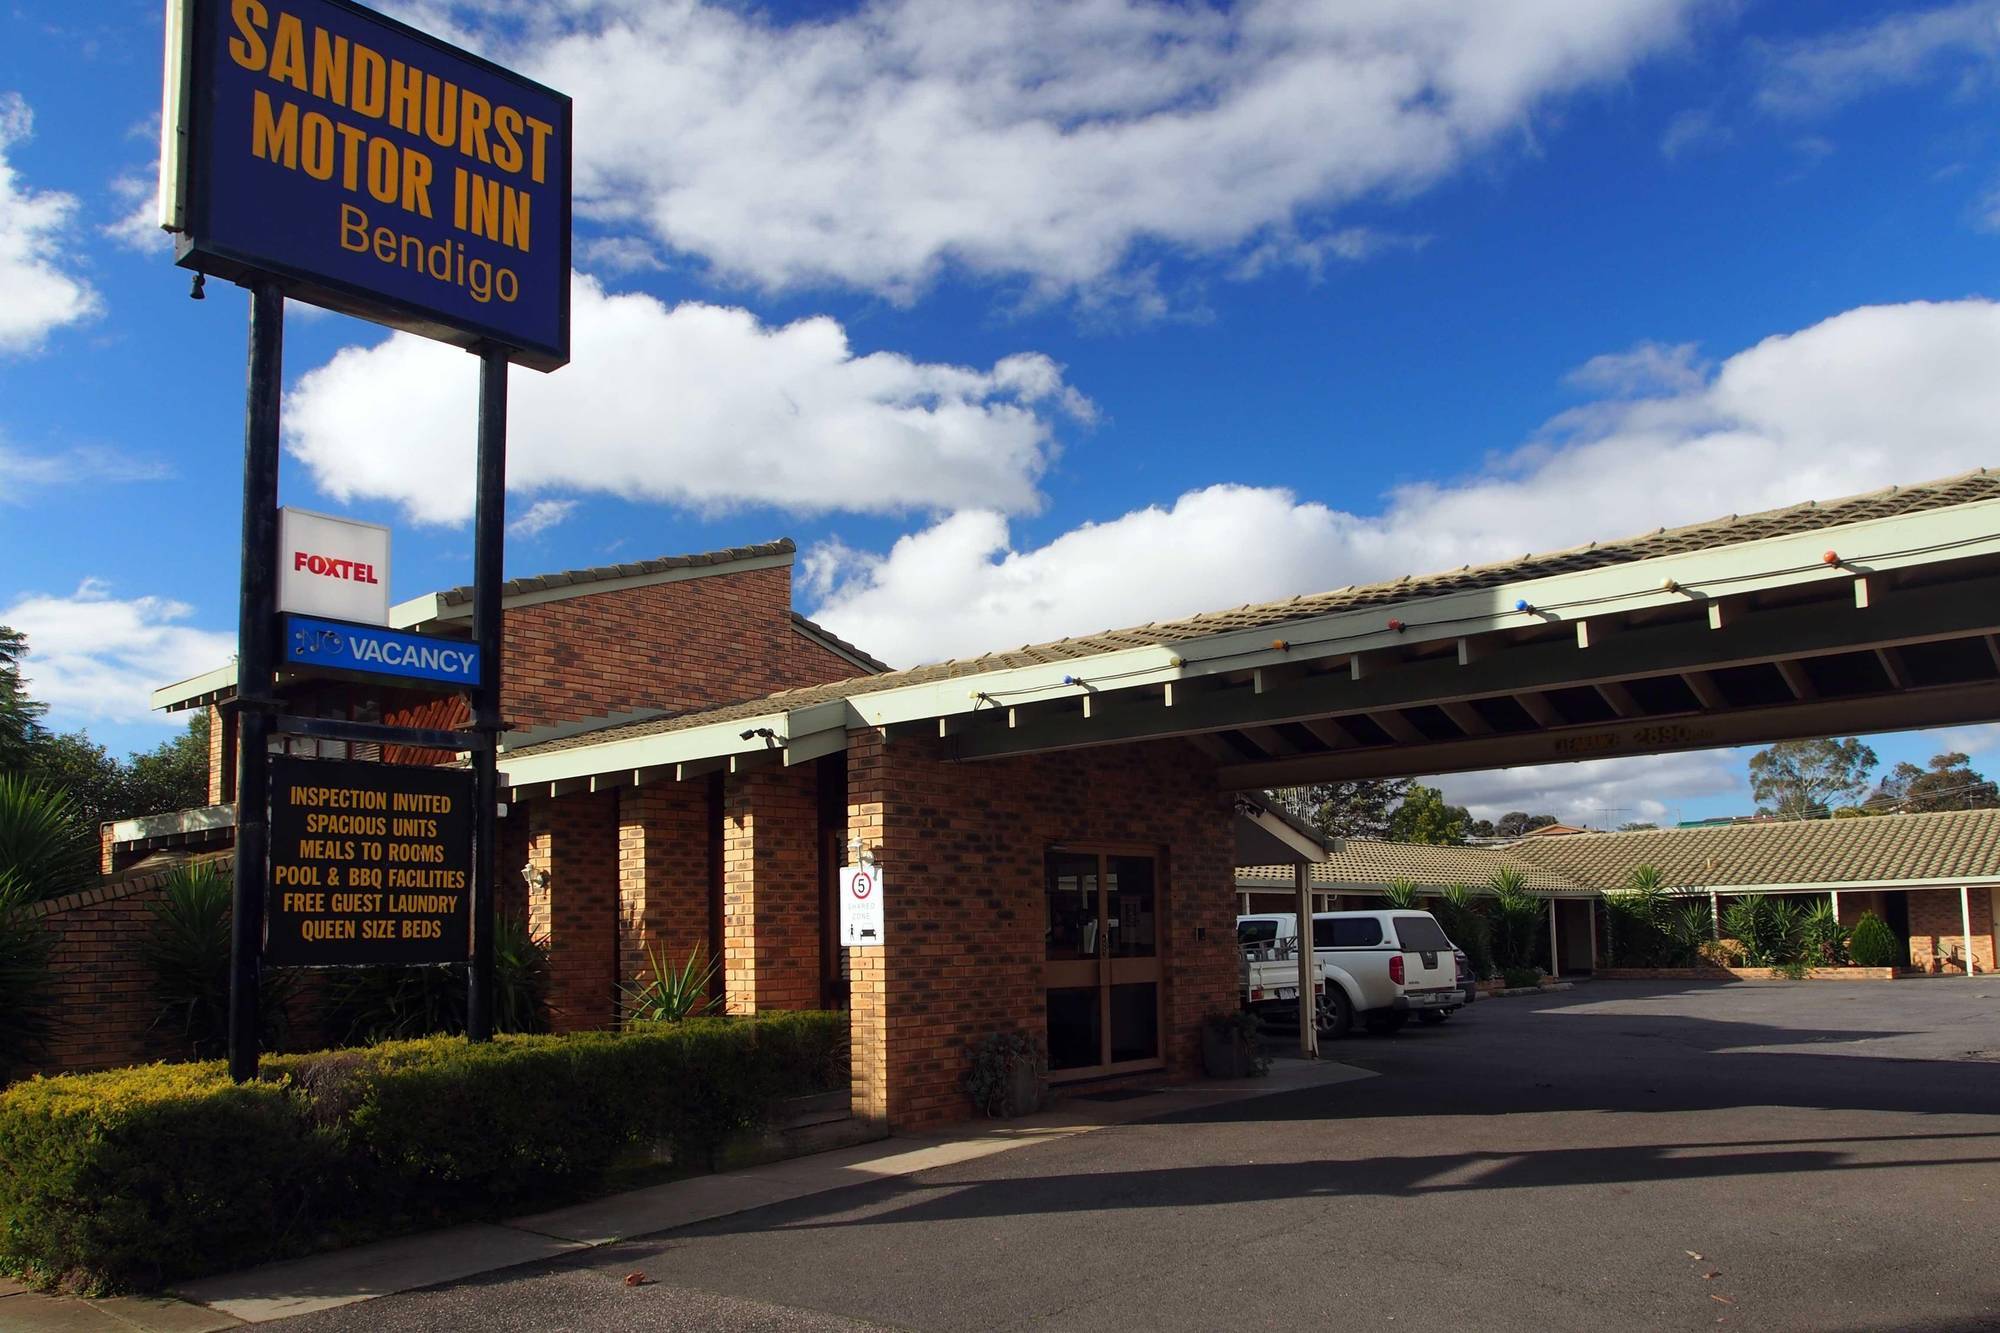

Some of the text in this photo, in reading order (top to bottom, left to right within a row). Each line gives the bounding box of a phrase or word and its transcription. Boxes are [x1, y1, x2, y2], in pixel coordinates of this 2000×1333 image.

[229, 0, 553, 184] SANDHURST
[252, 89, 532, 253] MOTOR INN
[340, 203, 519, 303] Bendigo
[295, 552, 378, 585] FOXTEL
[349, 636, 475, 674] VACANCY
[290, 786, 451, 814] INSPECTION INVITED
[306, 813, 437, 838] SPACIOUS UNITS
[300, 840, 444, 863] MEALS TO ROOMS
[275, 866, 465, 889] POOL & BBQ FACILITIES
[857, 878, 865, 893] 5
[283, 893, 458, 913] FREE GUEST LAUNDRY
[302, 920, 442, 941] QUEEN SIZE BEDS
